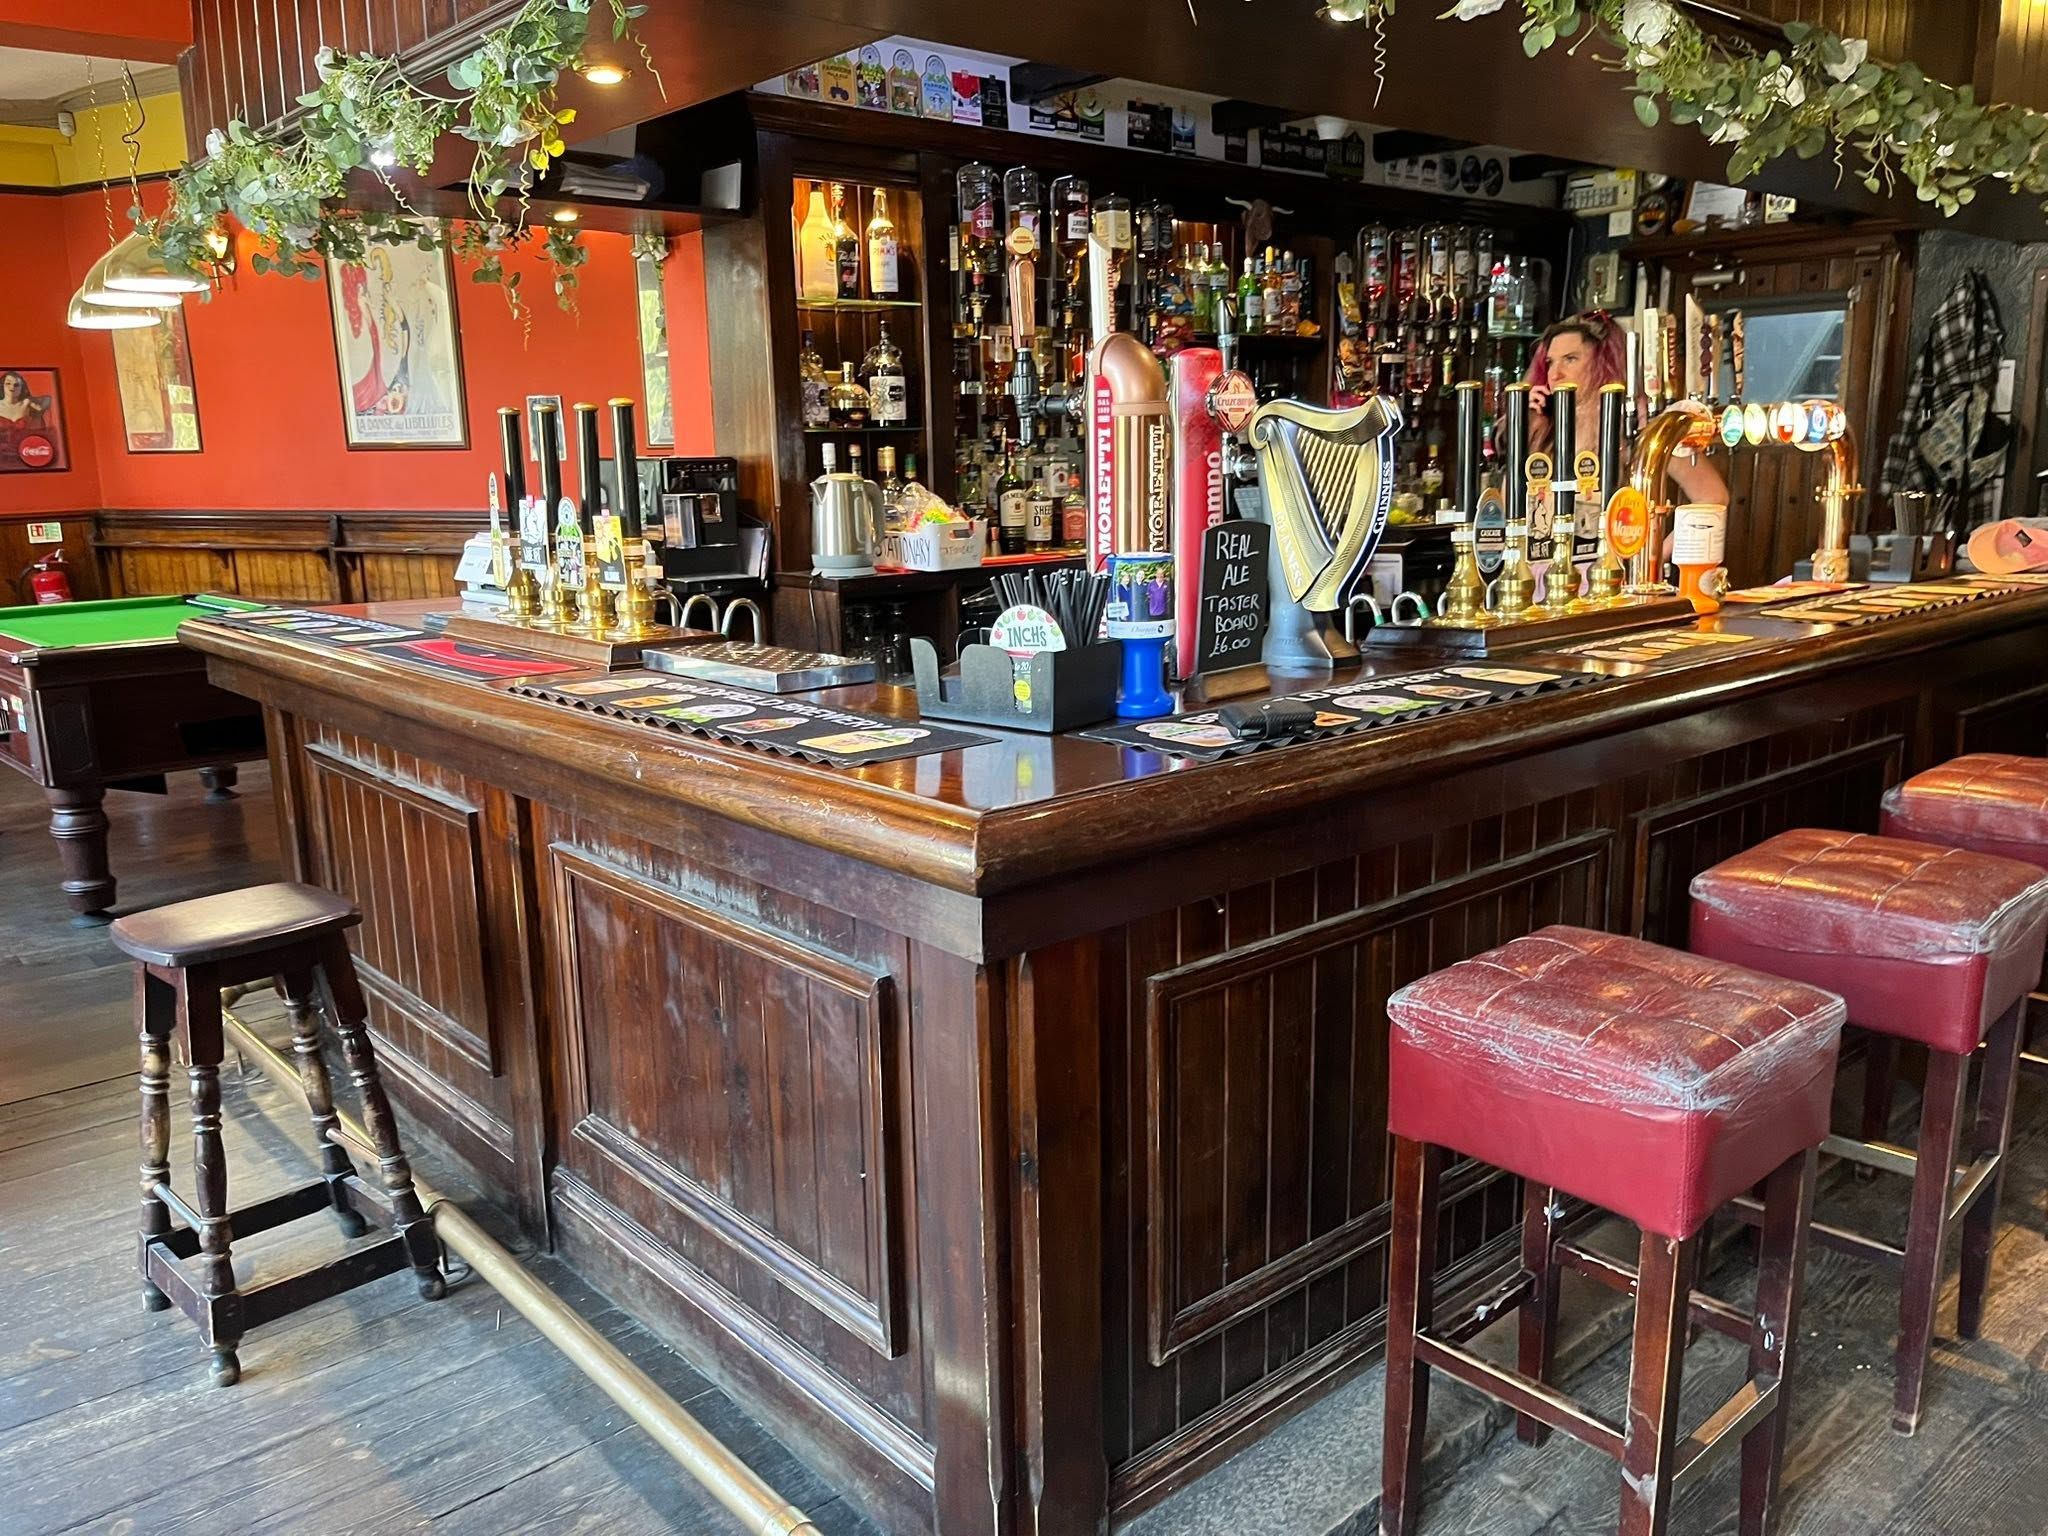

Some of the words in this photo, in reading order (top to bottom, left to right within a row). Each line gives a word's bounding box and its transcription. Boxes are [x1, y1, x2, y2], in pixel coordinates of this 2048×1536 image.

[1097, 428, 1112, 555] MORETTI
[1372, 461, 1392, 535] GUINNESS
[1216, 531, 1259, 560] REAL
[1275, 510, 1304, 588] GUINNESS
[1221, 563, 1250, 590] ALE
[1205, 593, 1260, 612] TASTER
[1215, 613, 1259, 633] BOARD
[1209, 635, 1251, 658] £6.00
[1322, 672, 1452, 696] BREWERY
[775, 702, 893, 730] BREWERY
